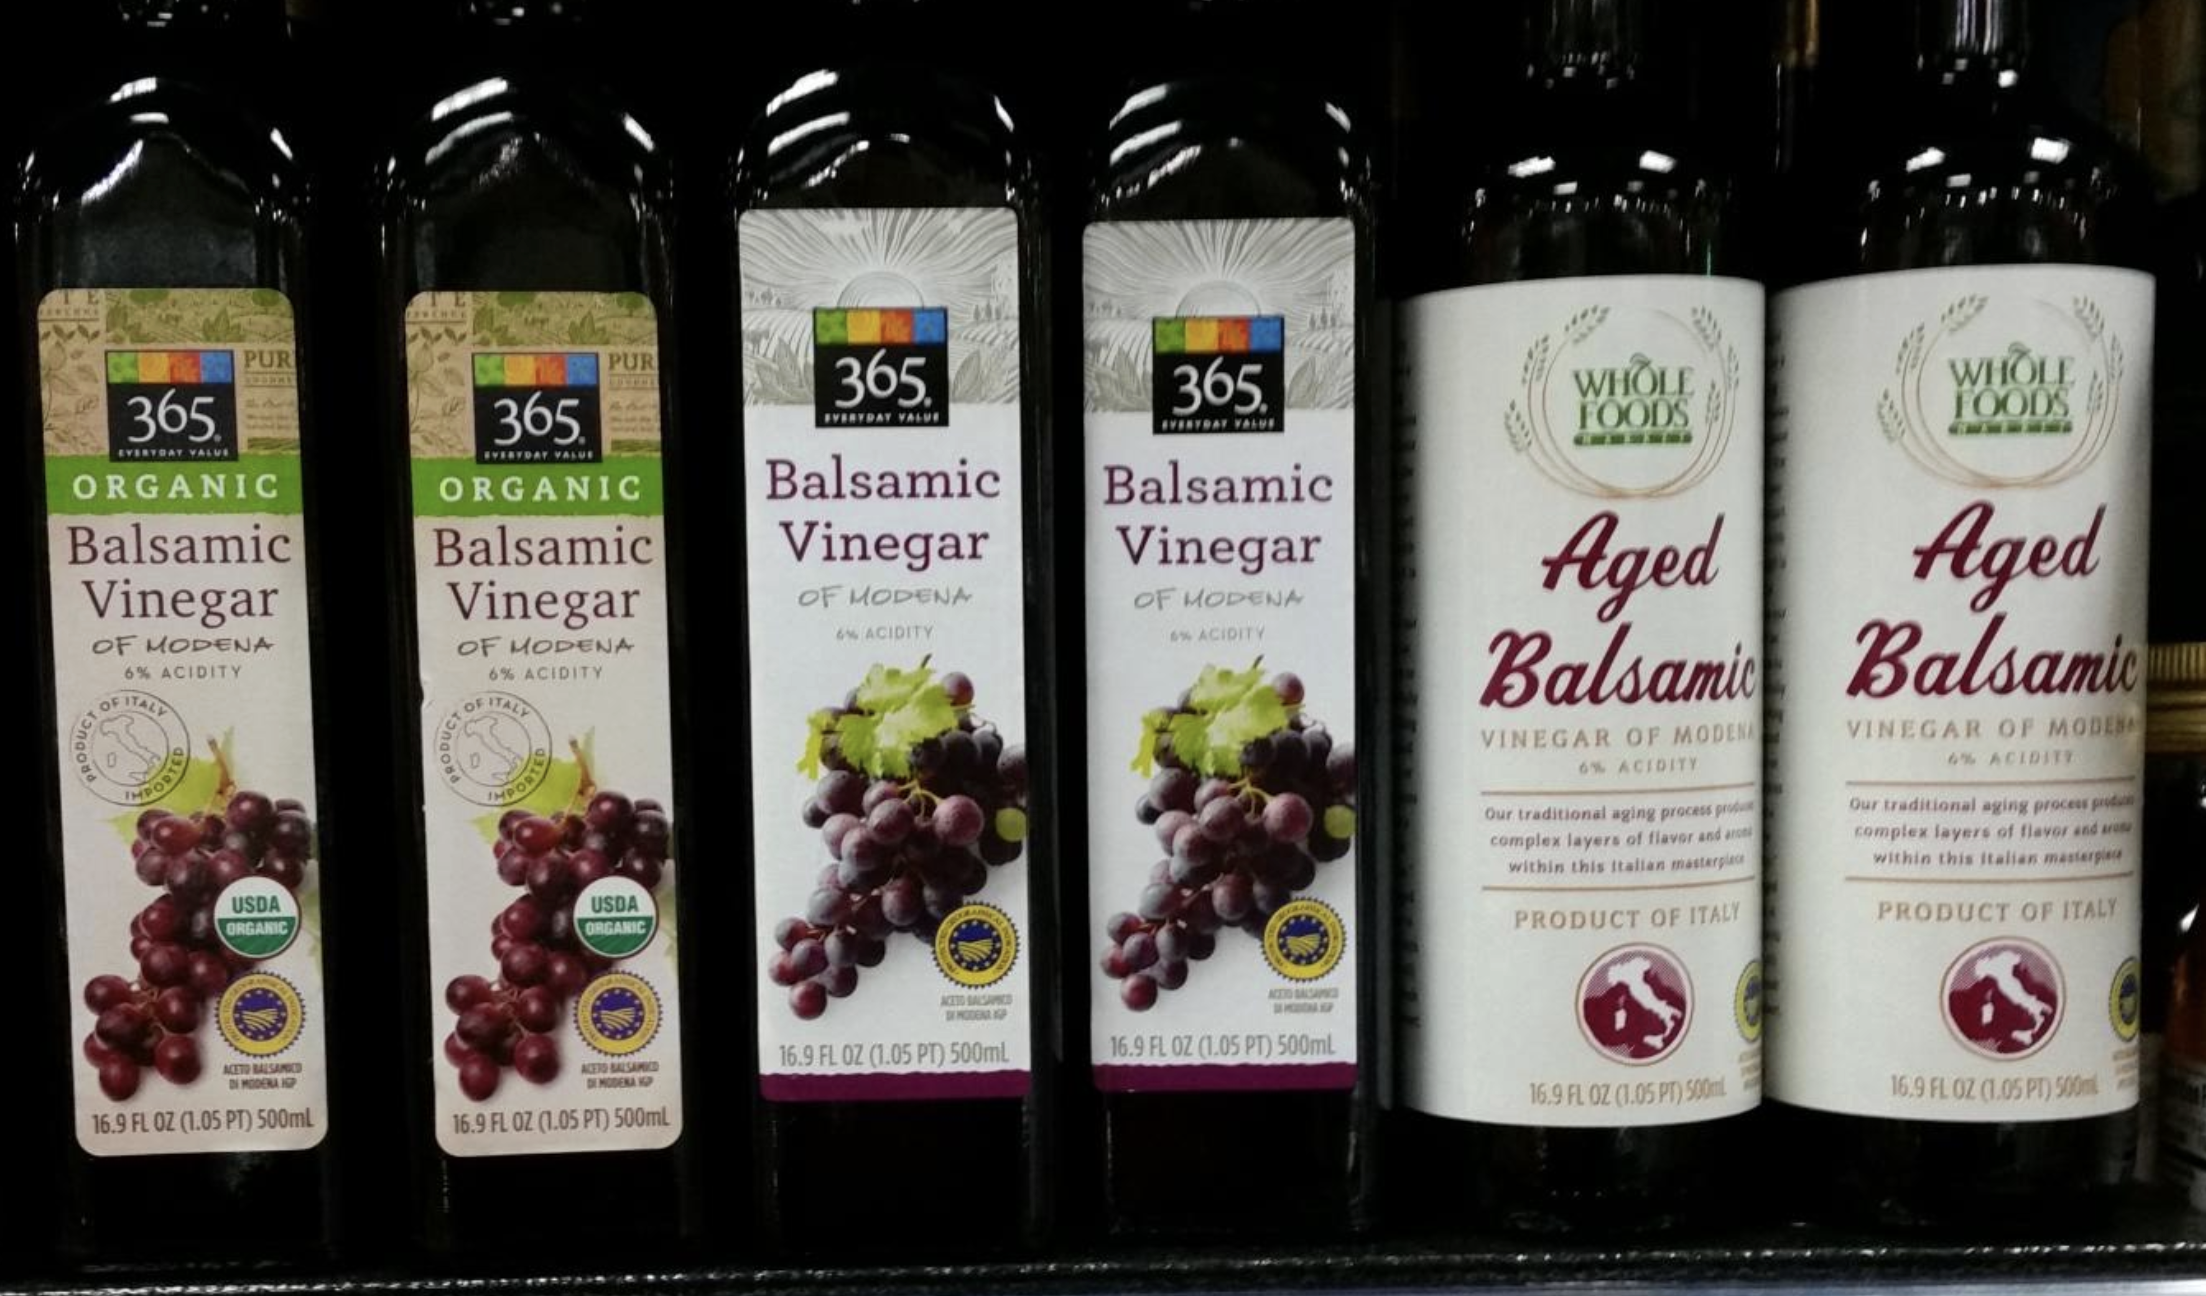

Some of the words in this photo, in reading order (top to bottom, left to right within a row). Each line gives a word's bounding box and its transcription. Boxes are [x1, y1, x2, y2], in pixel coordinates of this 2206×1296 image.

[1572, 356, 1695, 398] WHOLE
[1948, 344, 2075, 387] WHOLE
[1578, 398, 1689, 429] FOODS
[1954, 387, 2070, 419] FOODS
[824, 412, 892, 424] EVERYDAY
[899, 411, 940, 423] VALUE
[1162, 419, 1228, 432] EVERYDAY
[1234, 418, 1275, 430] VALUE
[118, 447, 184, 458] EVERYDAY
[189, 447, 230, 458] VALUE
[484, 450, 548, 461] EVERYDAY
[554, 450, 594, 461] VALUE
[72, 473, 278, 499] ORGANIC
[439, 475, 641, 502] ORGANIC
[766, 454, 1000, 501] Balsamic
[1103, 460, 1332, 505] Balsamic
[67, 522, 291, 566] Balsamic
[433, 524, 654, 567] Balsamic
[779, 520, 990, 573] Vinegar
[1116, 525, 1322, 575] Vinegar
[1541, 511, 1724, 623] Aged
[1913, 501, 2106, 613] Aged
[81, 578, 279, 629] Vinegar
[446, 580, 640, 630] Vinegar
[798, 585, 843, 608] OF
[851, 585, 972, 606] MODENA
[1134, 587, 1177, 610] OF
[1184, 588, 1304, 608] MODENA
[92, 635, 138, 656] OF
[146, 635, 275, 654] MODENA
[836, 628, 859, 641] 6%
[865, 626, 934, 640] ACIDITY
[1170, 630, 1192, 642] 6%
[1199, 627, 1266, 641] ACIDITY
[457, 637, 502, 657] OF
[510, 637, 634, 655] MODENA
[1846, 612, 2138, 698] Balsamic
[124, 666, 151, 680] 6%
[161, 665, 243, 680] ACIDITY
[489, 667, 514, 680] 6%
[525, 666, 603, 680] ACIDITY
[1480, 622, 1755, 708] Balsamic
[74, 710, 99, 784] PRODUCT
[99, 696, 119, 712] OF
[125, 695, 168, 718] ITALY
[439, 712, 462, 784] PRODUCT
[464, 697, 484, 713] OF
[488, 697, 530, 718] ITALY
[1480, 728, 1610, 749] VINEGAR
[1626, 727, 1661, 747] OF
[1847, 719, 1981, 739] VINEGAR
[1999, 718, 2035, 738] OF
[1579, 762, 1605, 775] 6%
[1618, 757, 1698, 774] ACIDITY
[1948, 752, 1975, 766] 6%
[1990, 752, 2074, 766] ACIDITY
[125, 746, 185, 801] IMPORTED
[488, 747, 546, 801] IMPORTED
[1485, 807, 1514, 821] Our
[1518, 806, 1607, 821] traditional
[1612, 804, 1655, 822] aging
[1660, 803, 1712, 821] process
[1850, 798, 1877, 811] Our
[1884, 797, 1976, 813] traditional
[1982, 797, 2028, 815] aging
[2034, 799, 2088, 815] process
[1490, 833, 1561, 849] complex
[1567, 834, 1620, 850] layers
[1626, 831, 1643, 845] of
[1649, 830, 1693, 845] flavor
[1698, 827, 1721, 842] and
[1855, 824, 1927, 840] complex
[1935, 825, 1990, 841] layers
[1997, 824, 2014, 839] of
[2020, 824, 2068, 839] flavor
[2073, 822, 2098, 836] and
[1509, 858, 1565, 874] within
[1571, 858, 1604, 873] this
[1611, 857, 1665, 873] Italian
[1873, 851, 1931, 866] within
[1938, 851, 1973, 866] this
[1981, 851, 2037, 865] Italian
[232, 895, 281, 915] USDA
[591, 895, 639, 913] USDA
[1515, 910, 1640, 929] PRODUCT
[1651, 908, 1681, 927] OF
[1690, 902, 1740, 924] ITALY
[1878, 902, 2010, 922] PRODUCT
[2021, 901, 2053, 921] OF
[2063, 897, 2117, 920] ITALY
[225, 920, 289, 937] ORGANIC
[584, 920, 646, 936] ORGANIC
[779, 1045, 814, 1066] 16.9
[819, 1044, 837, 1066] FL
[842, 1044, 864, 1064] OZ
[869, 1042, 912, 1068] (1.05
[918, 1042, 945, 1068] PT)
[951, 1041, 1010, 1064] 500mL
[1111, 1035, 1144, 1057] 16.9
[1150, 1035, 1167, 1057] FL
[1172, 1035, 1193, 1056] OZ
[1199, 1034, 1240, 1059] (1.05
[1245, 1034, 1273, 1059] PT)
[1277, 1034, 1336, 1056] 500mL
[1530, 1083, 1562, 1105] 16.9
[1568, 1083, 1584, 1105] FL
[1589, 1083, 1611, 1105] OZ
[1615, 1082, 1656, 1107] (1.05
[1659, 1081, 1683, 1105] PT)
[1686, 1077, 1727, 1100] 500mL
[1891, 1075, 1925, 1097] 16.9
[1930, 1076, 1949, 1098] FL
[1953, 1076, 1975, 1098] OZ
[1981, 1076, 2022, 1100] (1.05
[2027, 1075, 2051, 1099] PT)
[2056, 1073, 2098, 1096] 500mL
[93, 1113, 126, 1134] 16.9
[131, 1113, 149, 1133] FL
[154, 1111, 175, 1131] OZ
[180, 1110, 222, 1134] (1.05
[226, 1109, 253, 1133] PT)
[257, 1107, 314, 1129] 500mL
[453, 1113, 486, 1134] 16.9
[491, 1112, 508, 1133] FL
[513, 1111, 533, 1131] OZ
[538, 1110, 579, 1134] (1.05
[584, 1109, 610, 1132] PT)
[614, 1106, 671, 1129] 500mL
